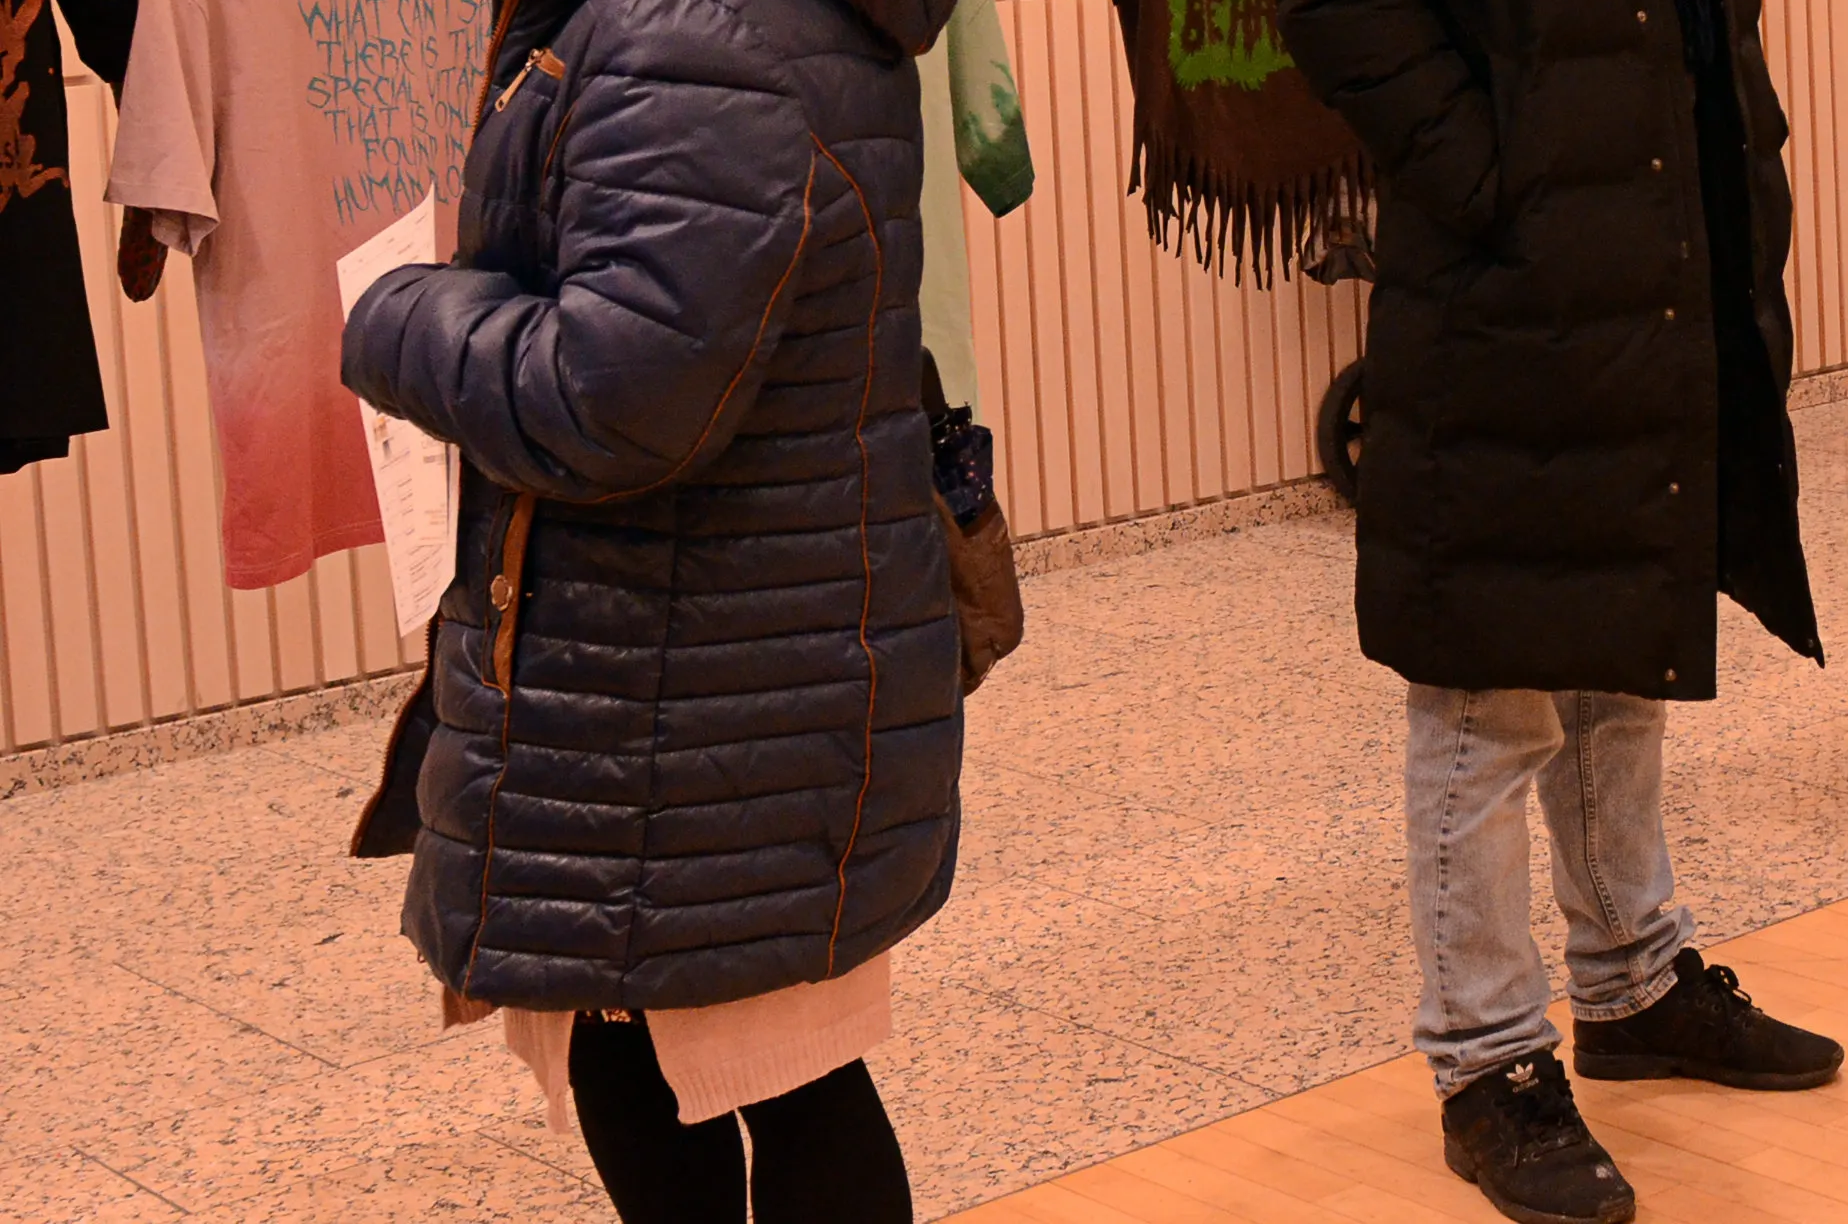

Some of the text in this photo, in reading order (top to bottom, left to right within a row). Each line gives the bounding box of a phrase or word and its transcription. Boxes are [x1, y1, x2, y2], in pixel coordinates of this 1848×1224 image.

[316, 35, 415, 78] THERE
[420, 35, 438, 69] IS
[306, 74, 419, 109] SPECIAL
[325, 101, 473, 144] THAT IS ONL
[364, 134, 437, 172] FOUND
[333, 165, 464, 224] HUMAN LO
